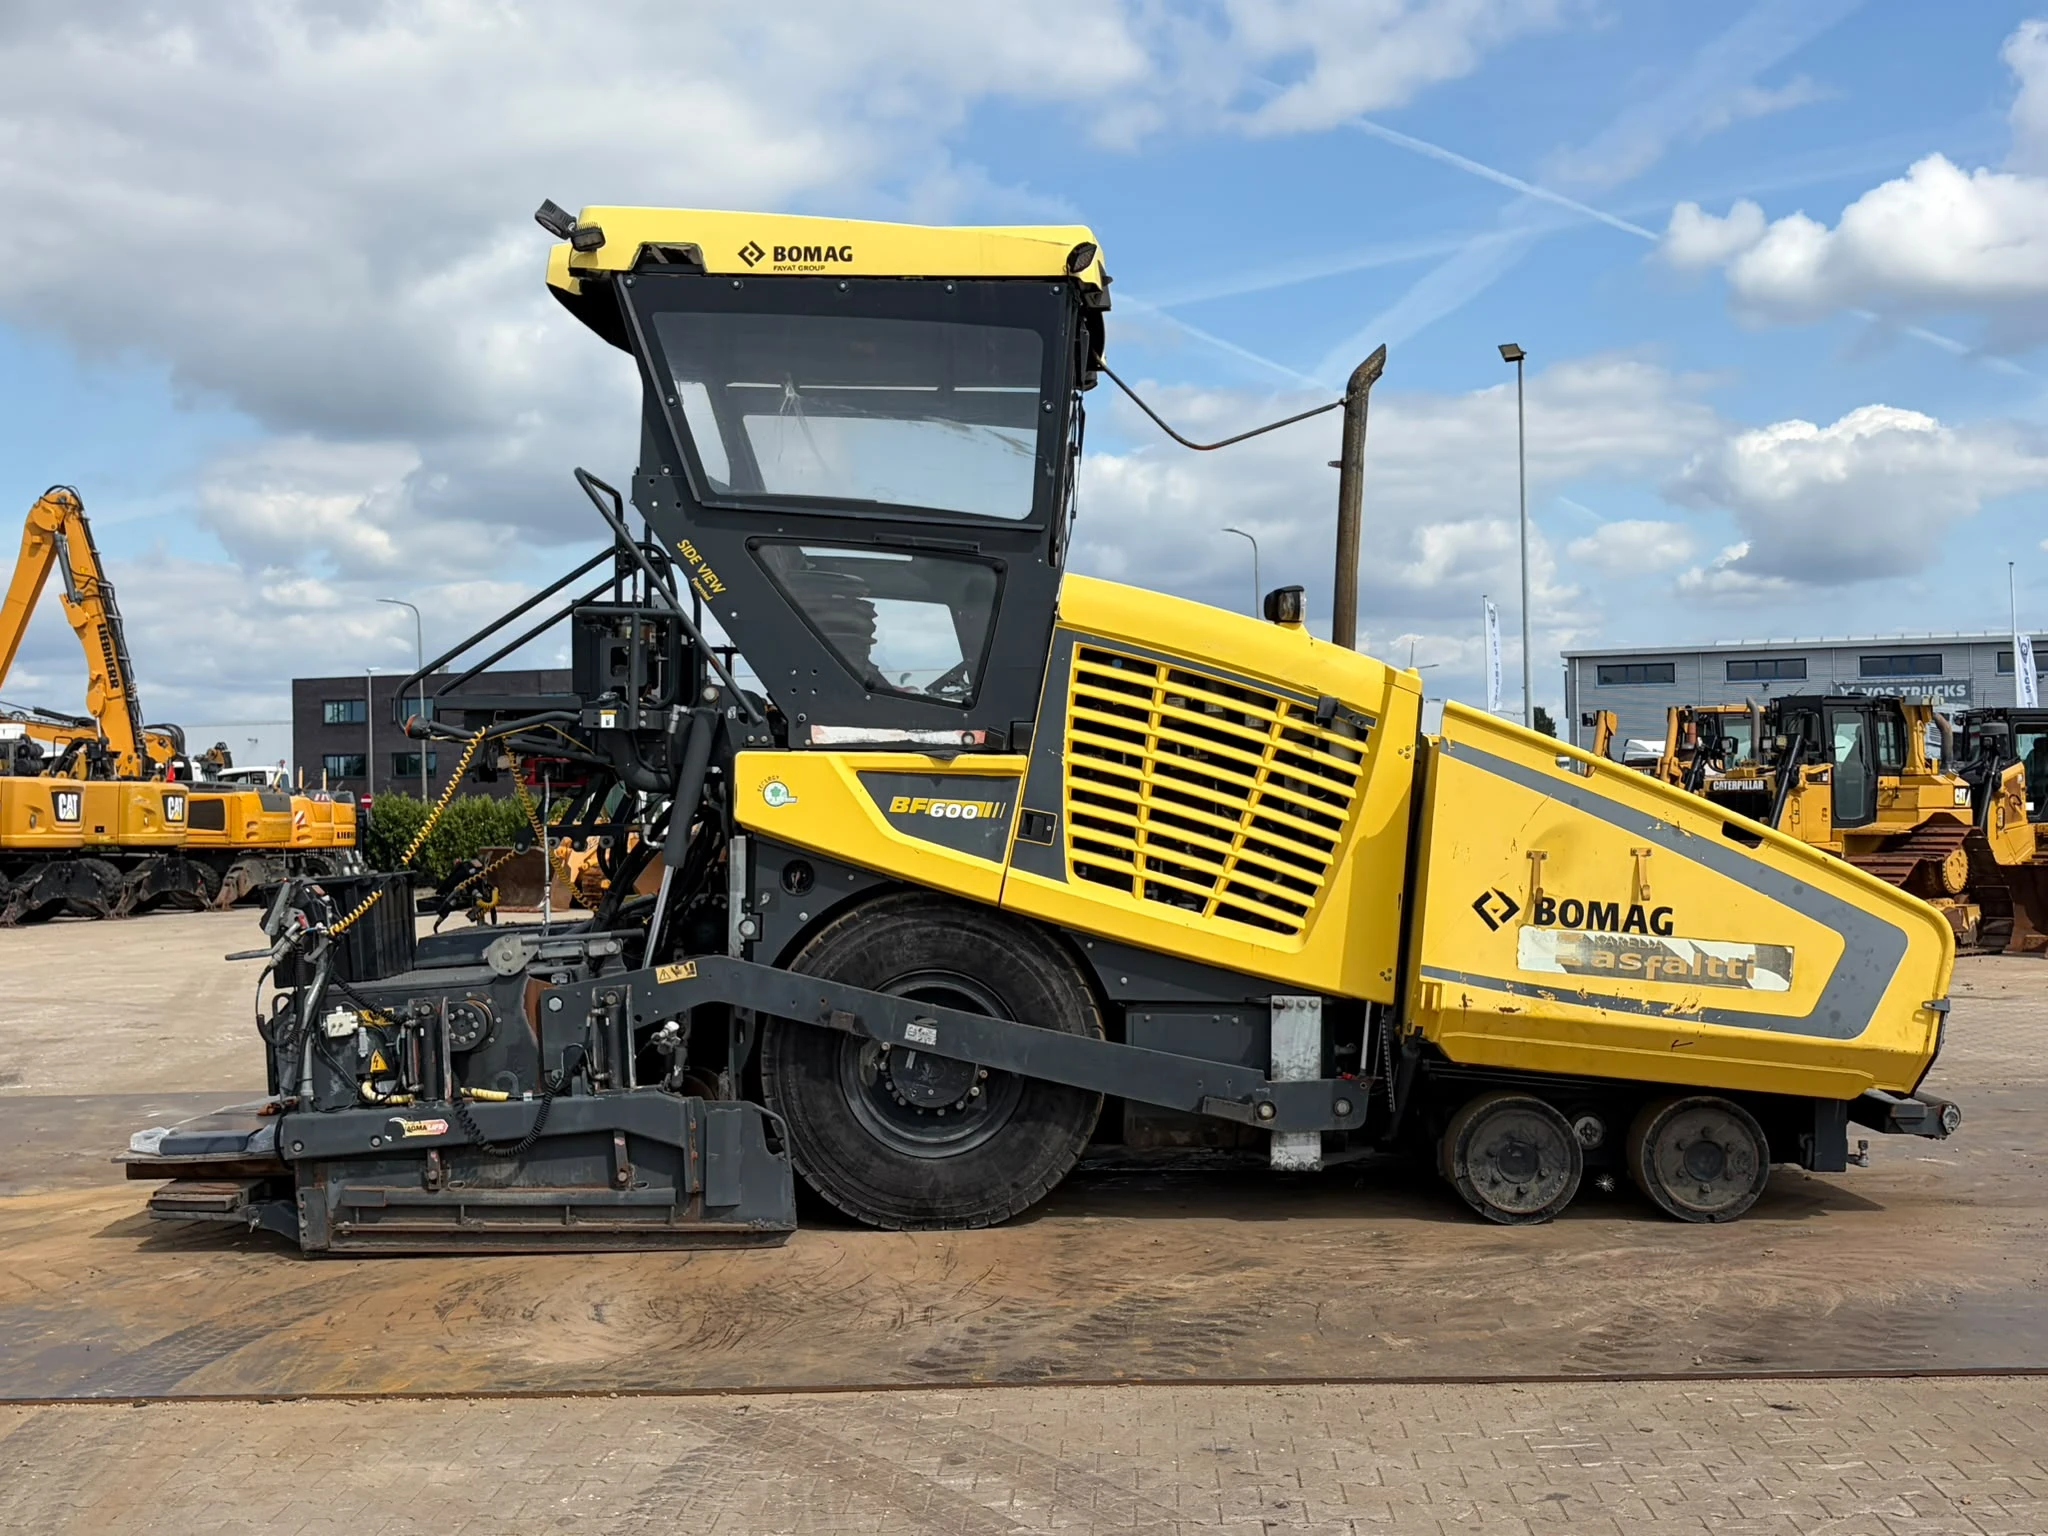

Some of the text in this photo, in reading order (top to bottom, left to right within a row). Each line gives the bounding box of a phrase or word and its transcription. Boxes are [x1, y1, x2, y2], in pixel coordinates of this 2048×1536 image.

[773, 246, 853, 262] BOMAG
[676, 539, 727, 593] SIDE VIEW
[97, 623, 120, 690] LIEBHERR
[1900, 684, 1967, 698] TRUCKS
[1713, 780, 1764, 790] CATERPILLAR
[58, 793, 78, 820] CAT
[167, 797, 183, 820] CAT
[889, 796, 979, 819] BF600
[1534, 897, 1673, 936] BOMAG
[1590, 949, 1755, 981] asfaltti
